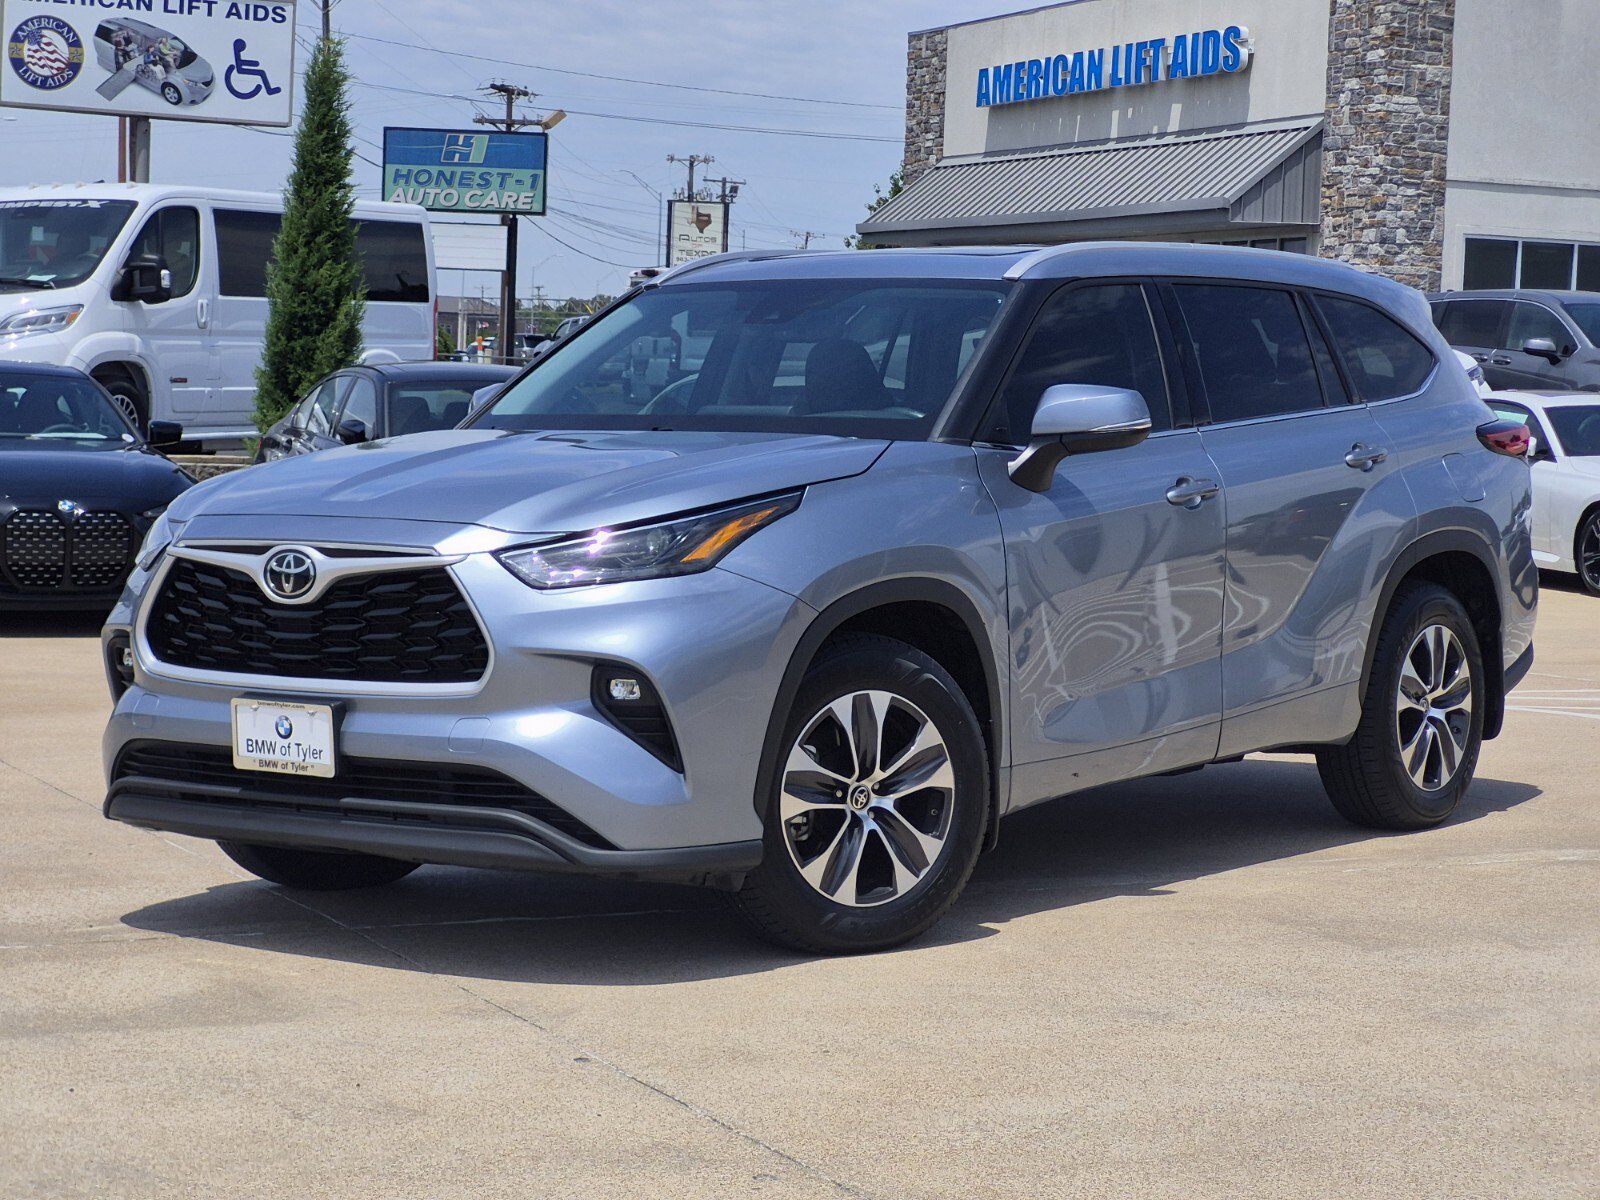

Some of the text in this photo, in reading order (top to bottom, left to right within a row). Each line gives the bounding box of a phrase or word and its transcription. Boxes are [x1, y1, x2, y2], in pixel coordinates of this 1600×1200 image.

[163, 0, 218, 17] LIFT
[225, 2, 287, 24] AIDS
[17, 18, 77, 43] AMERICAN
[19, 65, 74, 87] LIFT AIDS
[975, 25, 1245, 108] AMERICAN LIFT AIDS
[392, 168, 541, 191] HONEST-1
[387, 187, 536, 211] AUTO CARE
[257, 701, 306, 709] bmwoftyler.com
[246, 738, 324, 762] BMW of Tyler
[258, 759, 309, 773] BMW of Tyler
